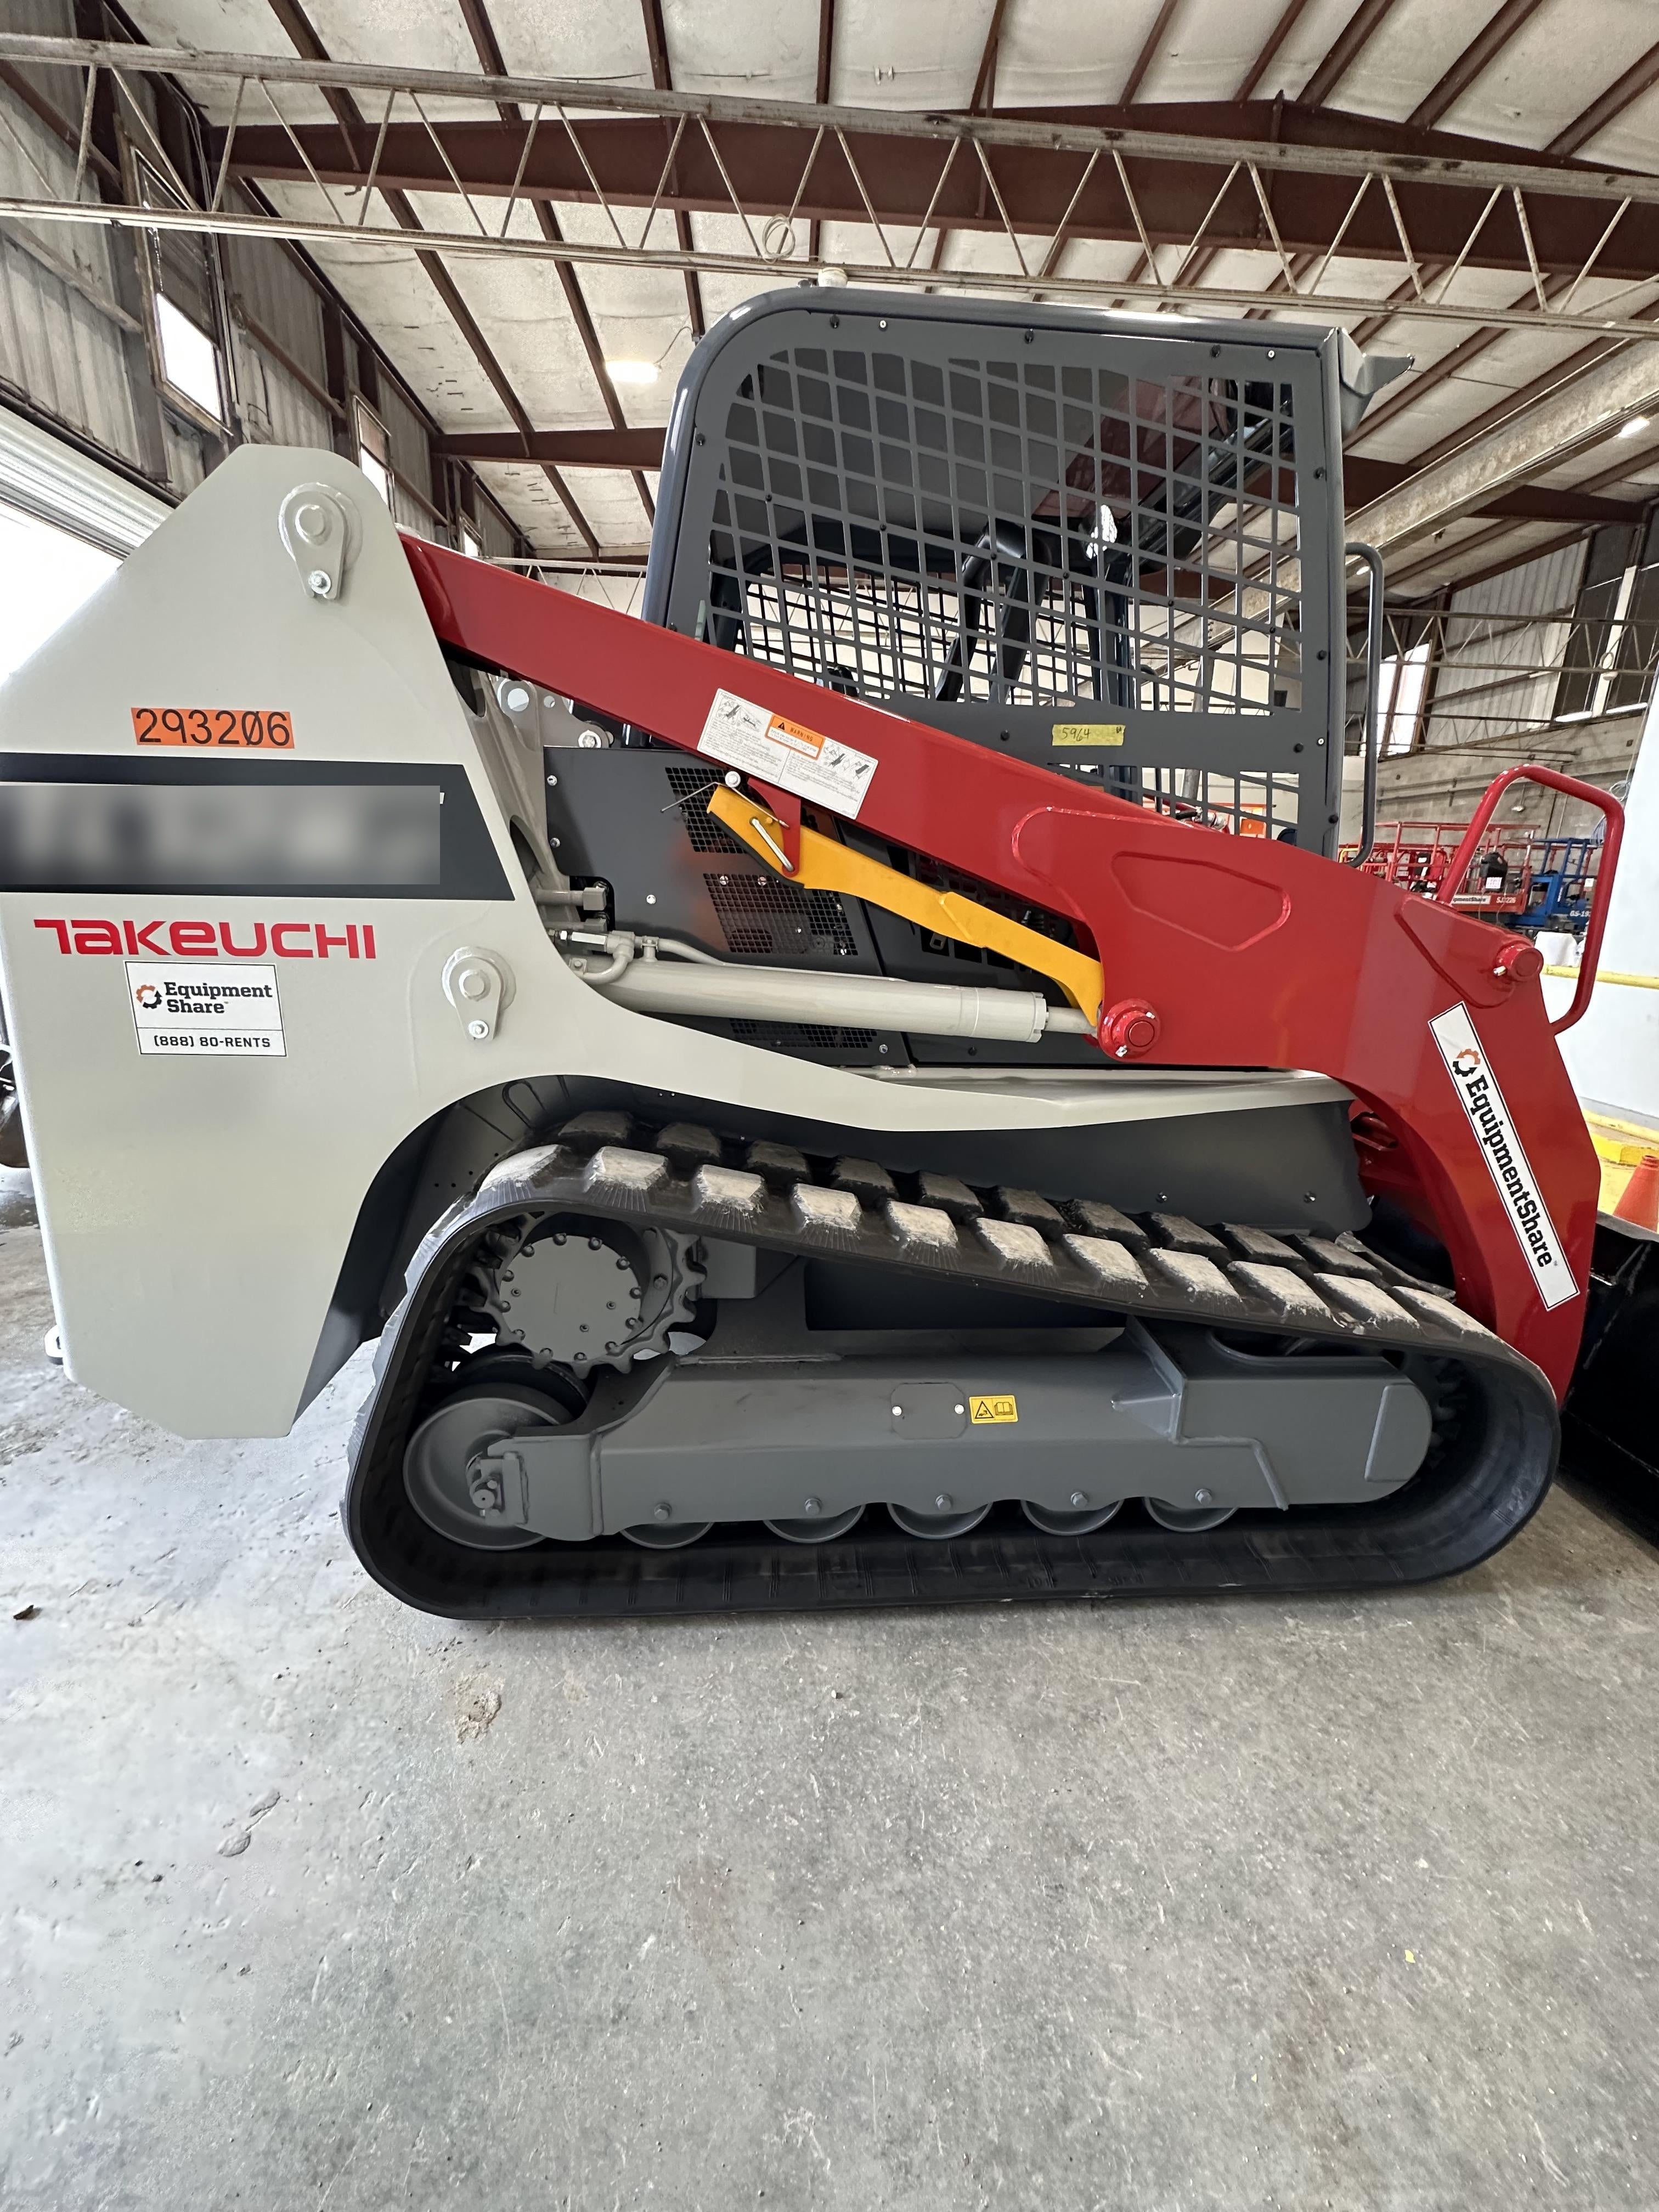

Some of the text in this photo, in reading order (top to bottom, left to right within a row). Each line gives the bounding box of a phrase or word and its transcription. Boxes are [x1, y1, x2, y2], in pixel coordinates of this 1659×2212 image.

[136, 708, 290, 746] 293206
[790, 727, 814, 742] WARNING
[34, 919, 376, 959] TAKEUCHI
[164, 981, 273, 1000] Equipment
[167, 999, 225, 1014] Share
[154, 1035, 270, 1047] (888) 80-RENTS
[1465, 1074, 1553, 1267] EquipmentShare
